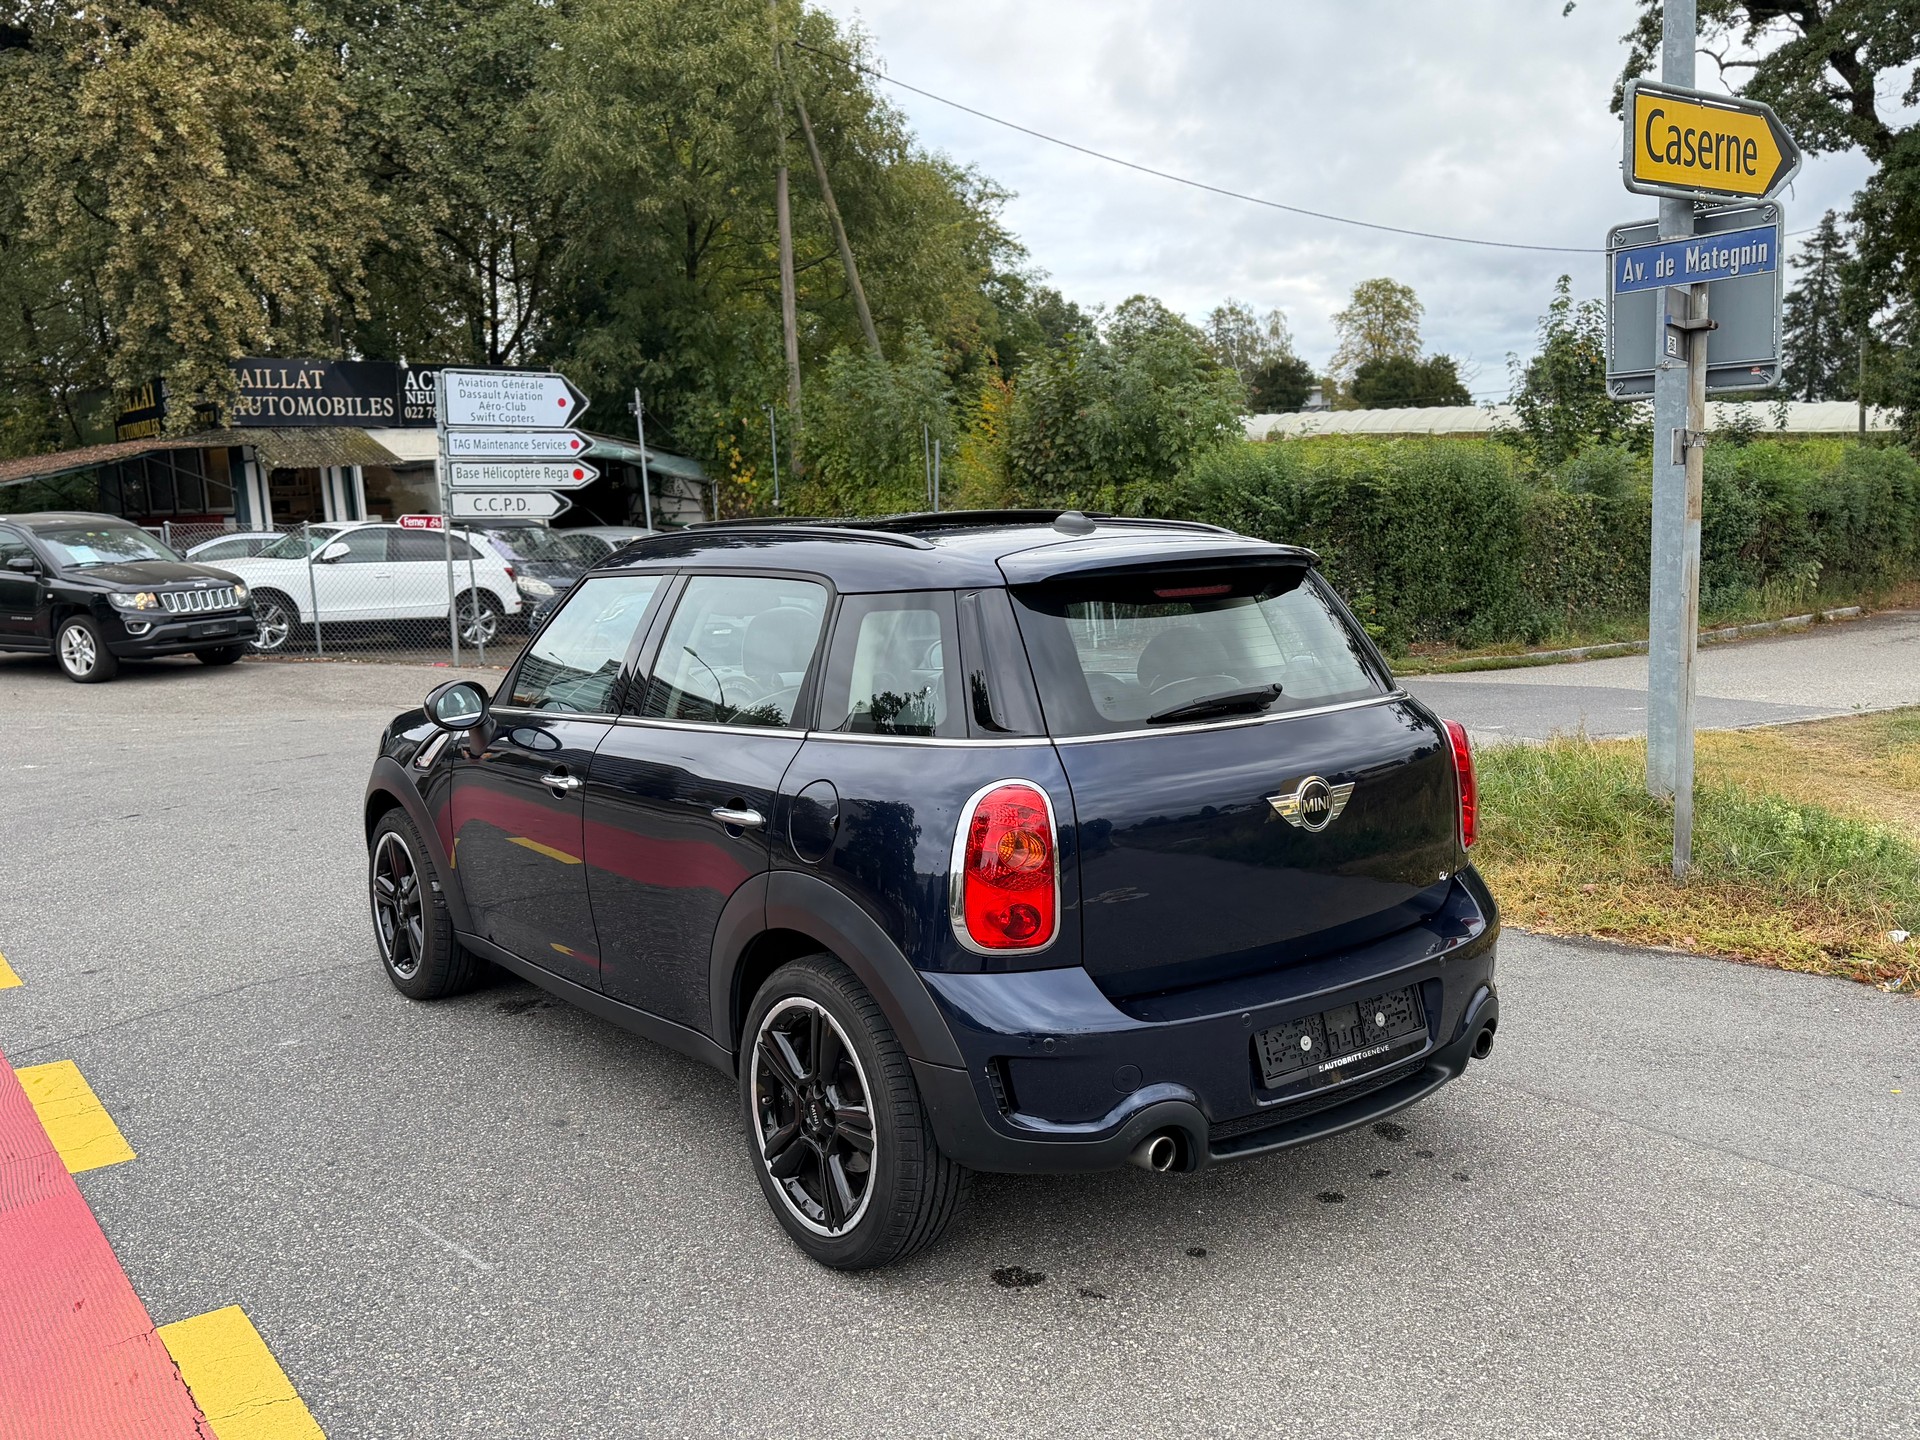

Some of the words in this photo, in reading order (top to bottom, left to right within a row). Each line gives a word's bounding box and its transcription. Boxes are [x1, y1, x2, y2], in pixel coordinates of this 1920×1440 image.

[1645, 108, 1758, 176] Caserne
[1622, 256, 1649, 284] Av.
[1655, 251, 1675, 279] de
[1685, 241, 1768, 276] Mategnin
[404, 370, 437, 390] AC
[457, 377, 499, 388] Aviation
[501, 379, 544, 390] Générale
[459, 389, 501, 399] Dassault
[504, 391, 543, 401] Aviation
[231, 395, 394, 417] AUTOMOBILES
[404, 406, 424, 419] 022
[478, 401, 527, 412] Aéro-Club
[470, 412, 495, 422] Swift
[498, 413, 535, 424] Copters
[453, 439, 471, 449] TAG
[473, 438, 528, 450] Maintenance
[531, 439, 567, 450] Services
[456, 467, 480, 479] Base
[483, 466, 540, 482] Hélicoptère
[544, 467, 569, 482] Rega
[473, 498, 531, 512] C.C.P.D.
[403, 517, 427, 529] Ferney
[1302, 795, 1330, 814] MINI
